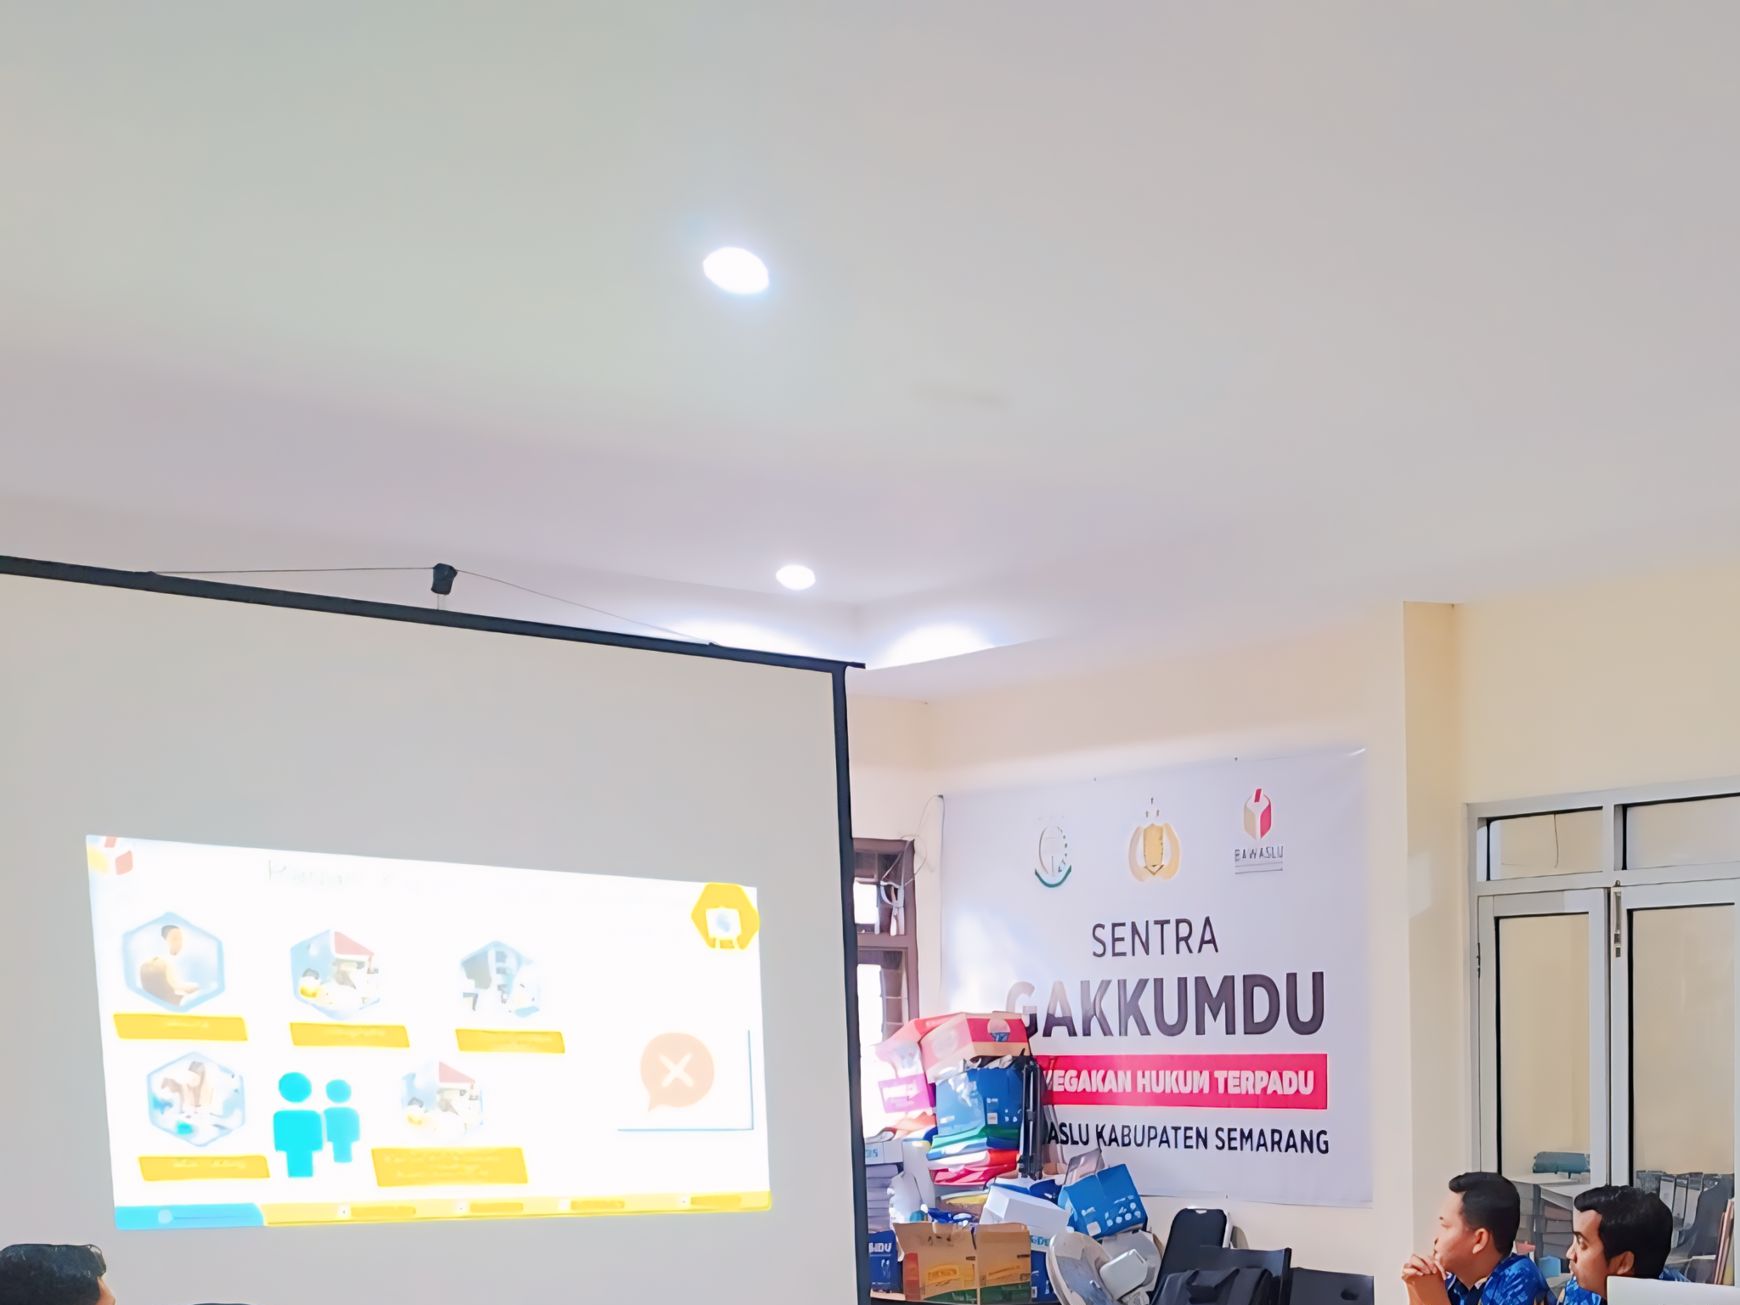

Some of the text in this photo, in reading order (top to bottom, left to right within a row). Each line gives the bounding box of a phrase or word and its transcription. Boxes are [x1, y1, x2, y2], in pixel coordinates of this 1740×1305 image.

[1234, 846, 1284, 861] BAWASLU
[1092, 915, 1219, 958] SENTRA
[1007, 971, 1324, 1037] GAKKUMDU
[1138, 1070, 1208, 1094] HUKUM
[1214, 1070, 1314, 1095] TERPADU
[1096, 1124, 1208, 1150] KABUPATEN
[1215, 1127, 1329, 1154] SEMARANG
